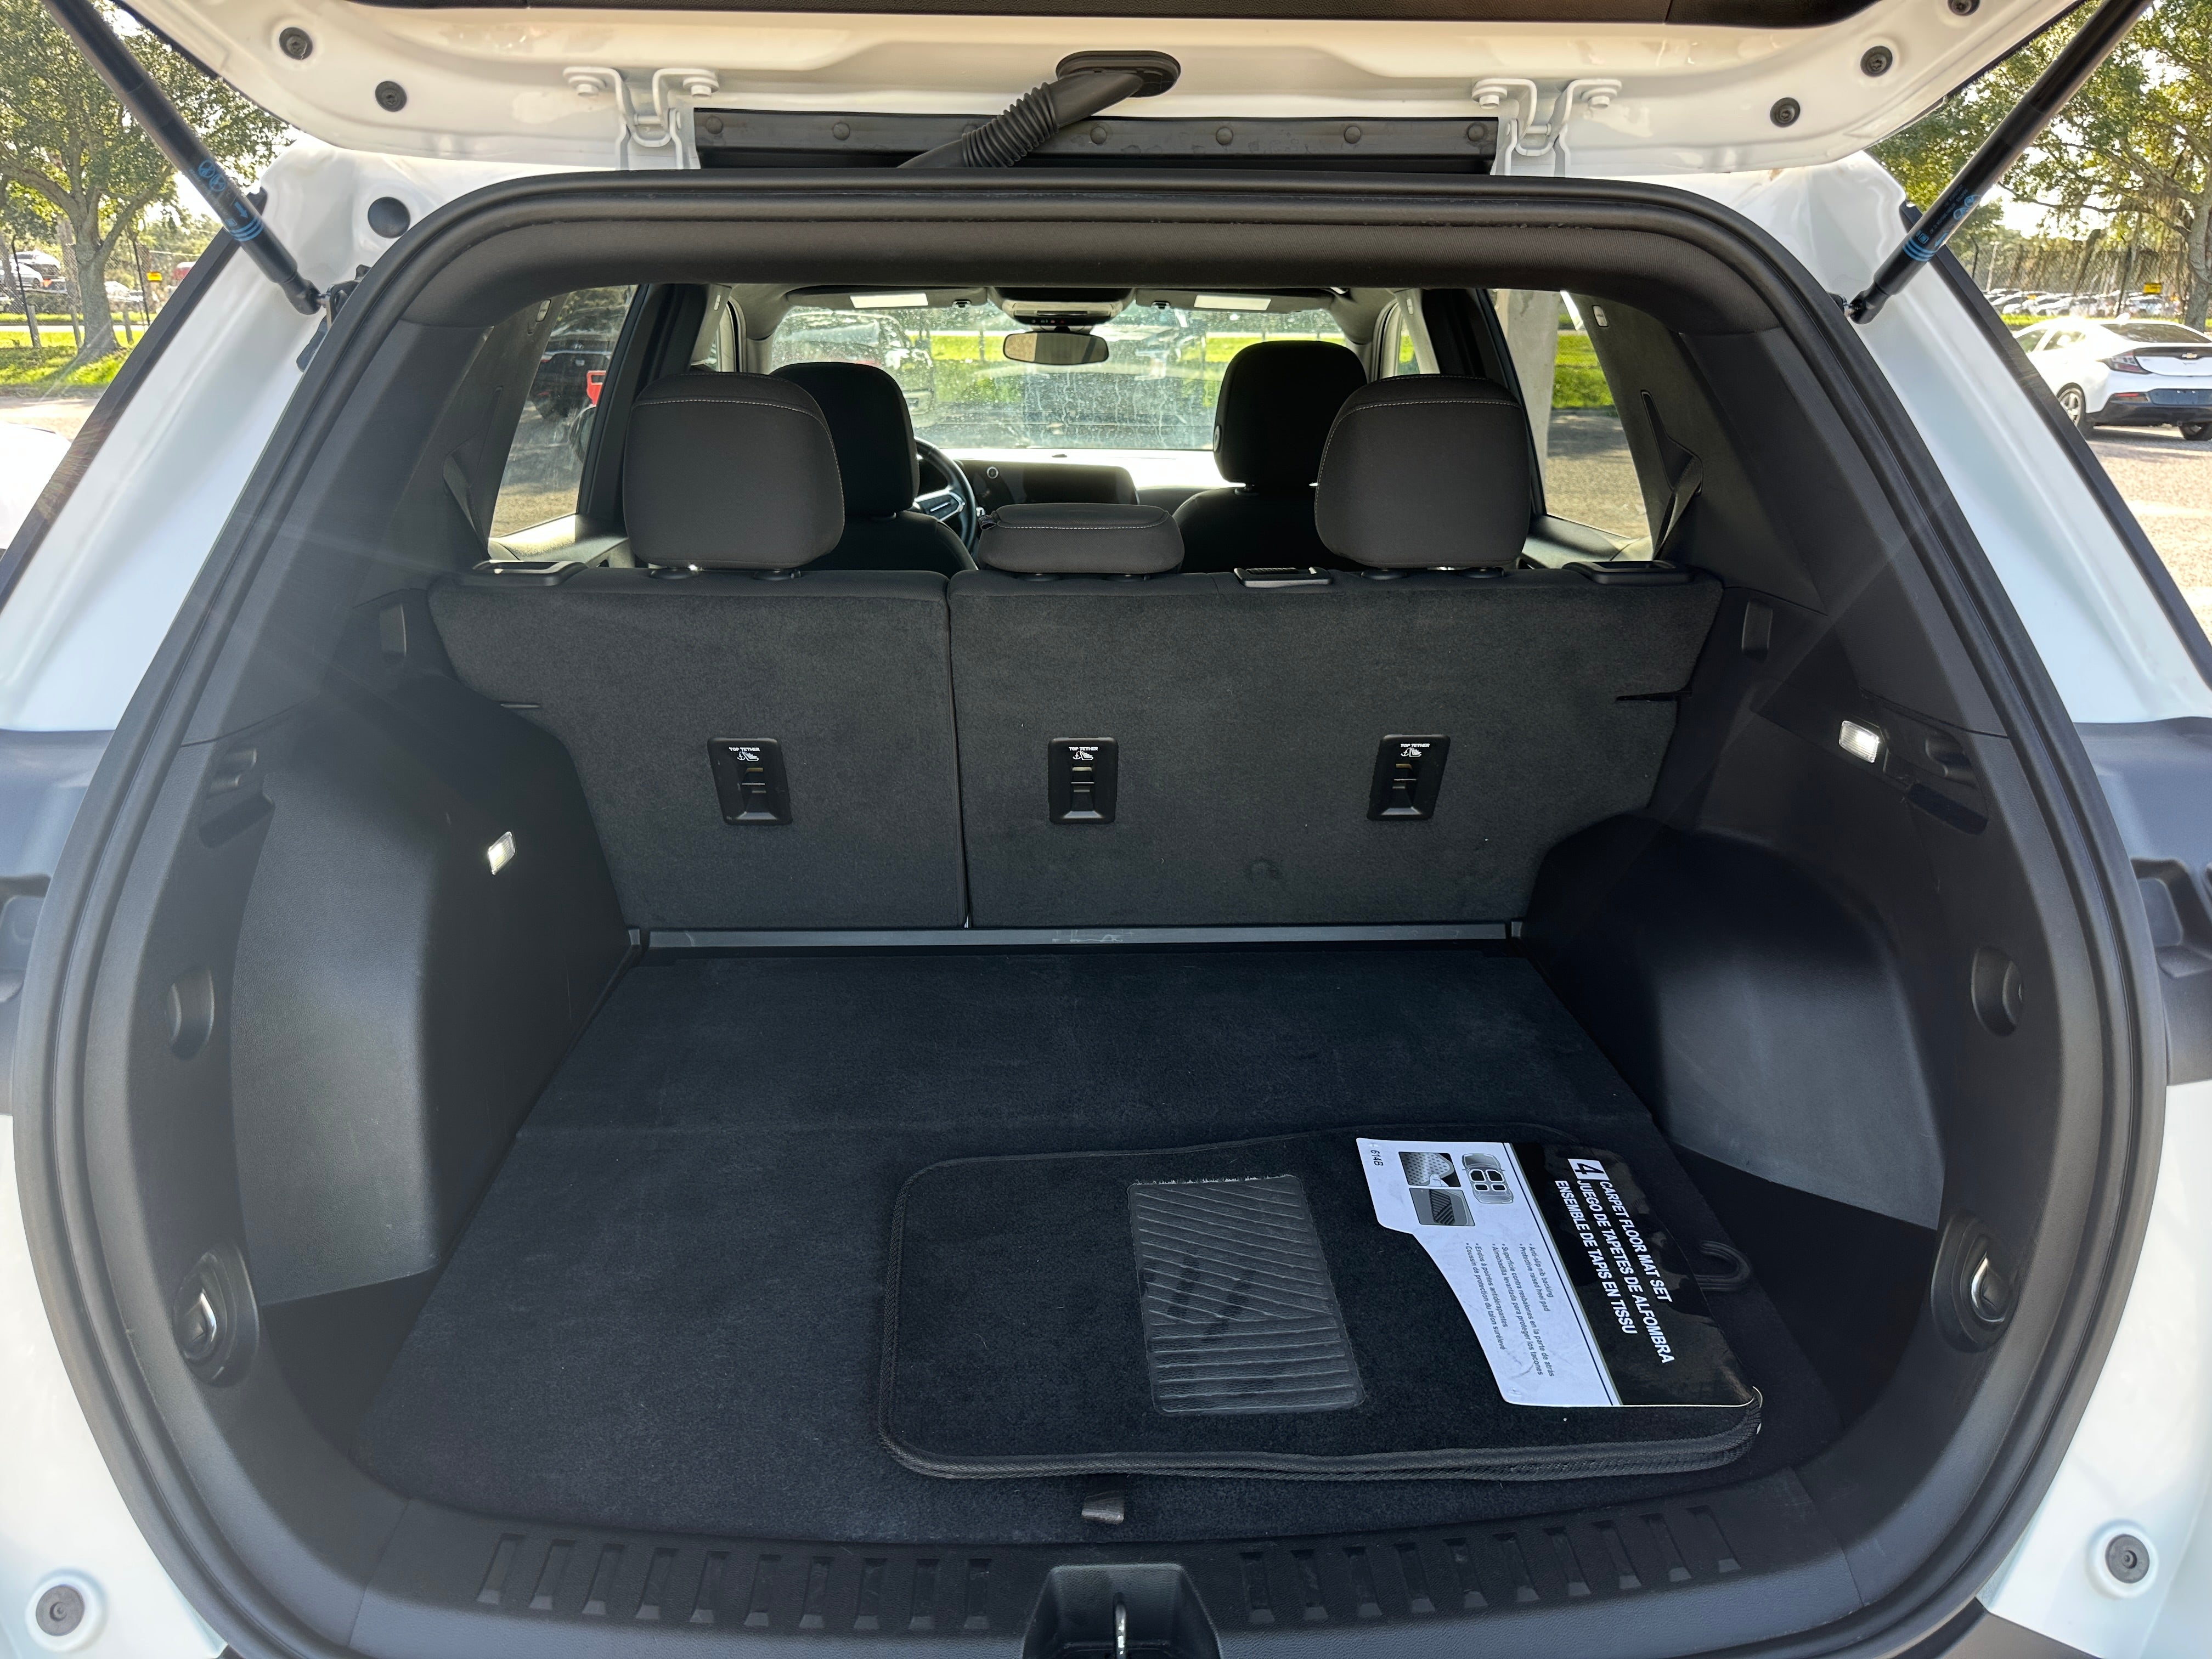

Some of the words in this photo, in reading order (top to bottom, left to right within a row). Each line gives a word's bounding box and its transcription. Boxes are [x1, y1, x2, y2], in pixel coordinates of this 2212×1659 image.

[1370, 1150, 1384, 1166] 614B
[1575, 1162, 1604, 1174] 4
[1555, 1180, 1590, 1230] ENSEMBLE
[1577, 1180, 1602, 1211] JUEGO
[1593, 1214, 1611, 1226] DE
[1579, 1233, 1598, 1246] DE
[1600, 1181, 1629, 1217] CARPET
[1618, 1219, 1647, 1252] FLOOR
[1637, 1254, 1660, 1277] MAT
[1650, 1279, 1672, 1302] SET
[1601, 1228, 1634, 1274] TAPETES
[1475, 1246, 1485, 1261] Endos
[1481, 1267, 1493, 1285] pointes
[1519, 1246, 1533, 1271] Protective
[1529, 1246, 1542, 1267] Anti-slip
[1542, 1277, 1554, 1297] backing
[1588, 1249, 1612, 1278] TAPIS
[1466, 1246, 1477, 1266] Coussin
[1474, 1274, 1489, 1301] protection
[1487, 1311, 1497, 1325] talon
[1529, 1272, 1541, 1288] raised
[1535, 1289, 1546, 1300] heel
[1601, 1282, 1621, 1296] EN
[1623, 1277, 1643, 1292] DE
[1492, 1246, 1507, 1275] Almohadilla
[1503, 1276, 1517, 1301] levantada
[1511, 1302, 1521, 1314] para
[1517, 1315, 1531, 1340] proteger
[1526, 1341, 1534, 1350] los
[1530, 1351, 1543, 1375] tacones
[1502, 1246, 1515, 1271] Superficie
[1511, 1272, 1522, 1289] contra
[1518, 1290, 1533, 1319] resbalones
[1534, 1335, 1545, 1351] parte
[1544, 1361, 1555, 1376] atrás
[1539, 1301, 1550, 1311] pad
[1611, 1299, 1637, 1333] TISSU
[1632, 1294, 1674, 1363] ALFOMBRA
